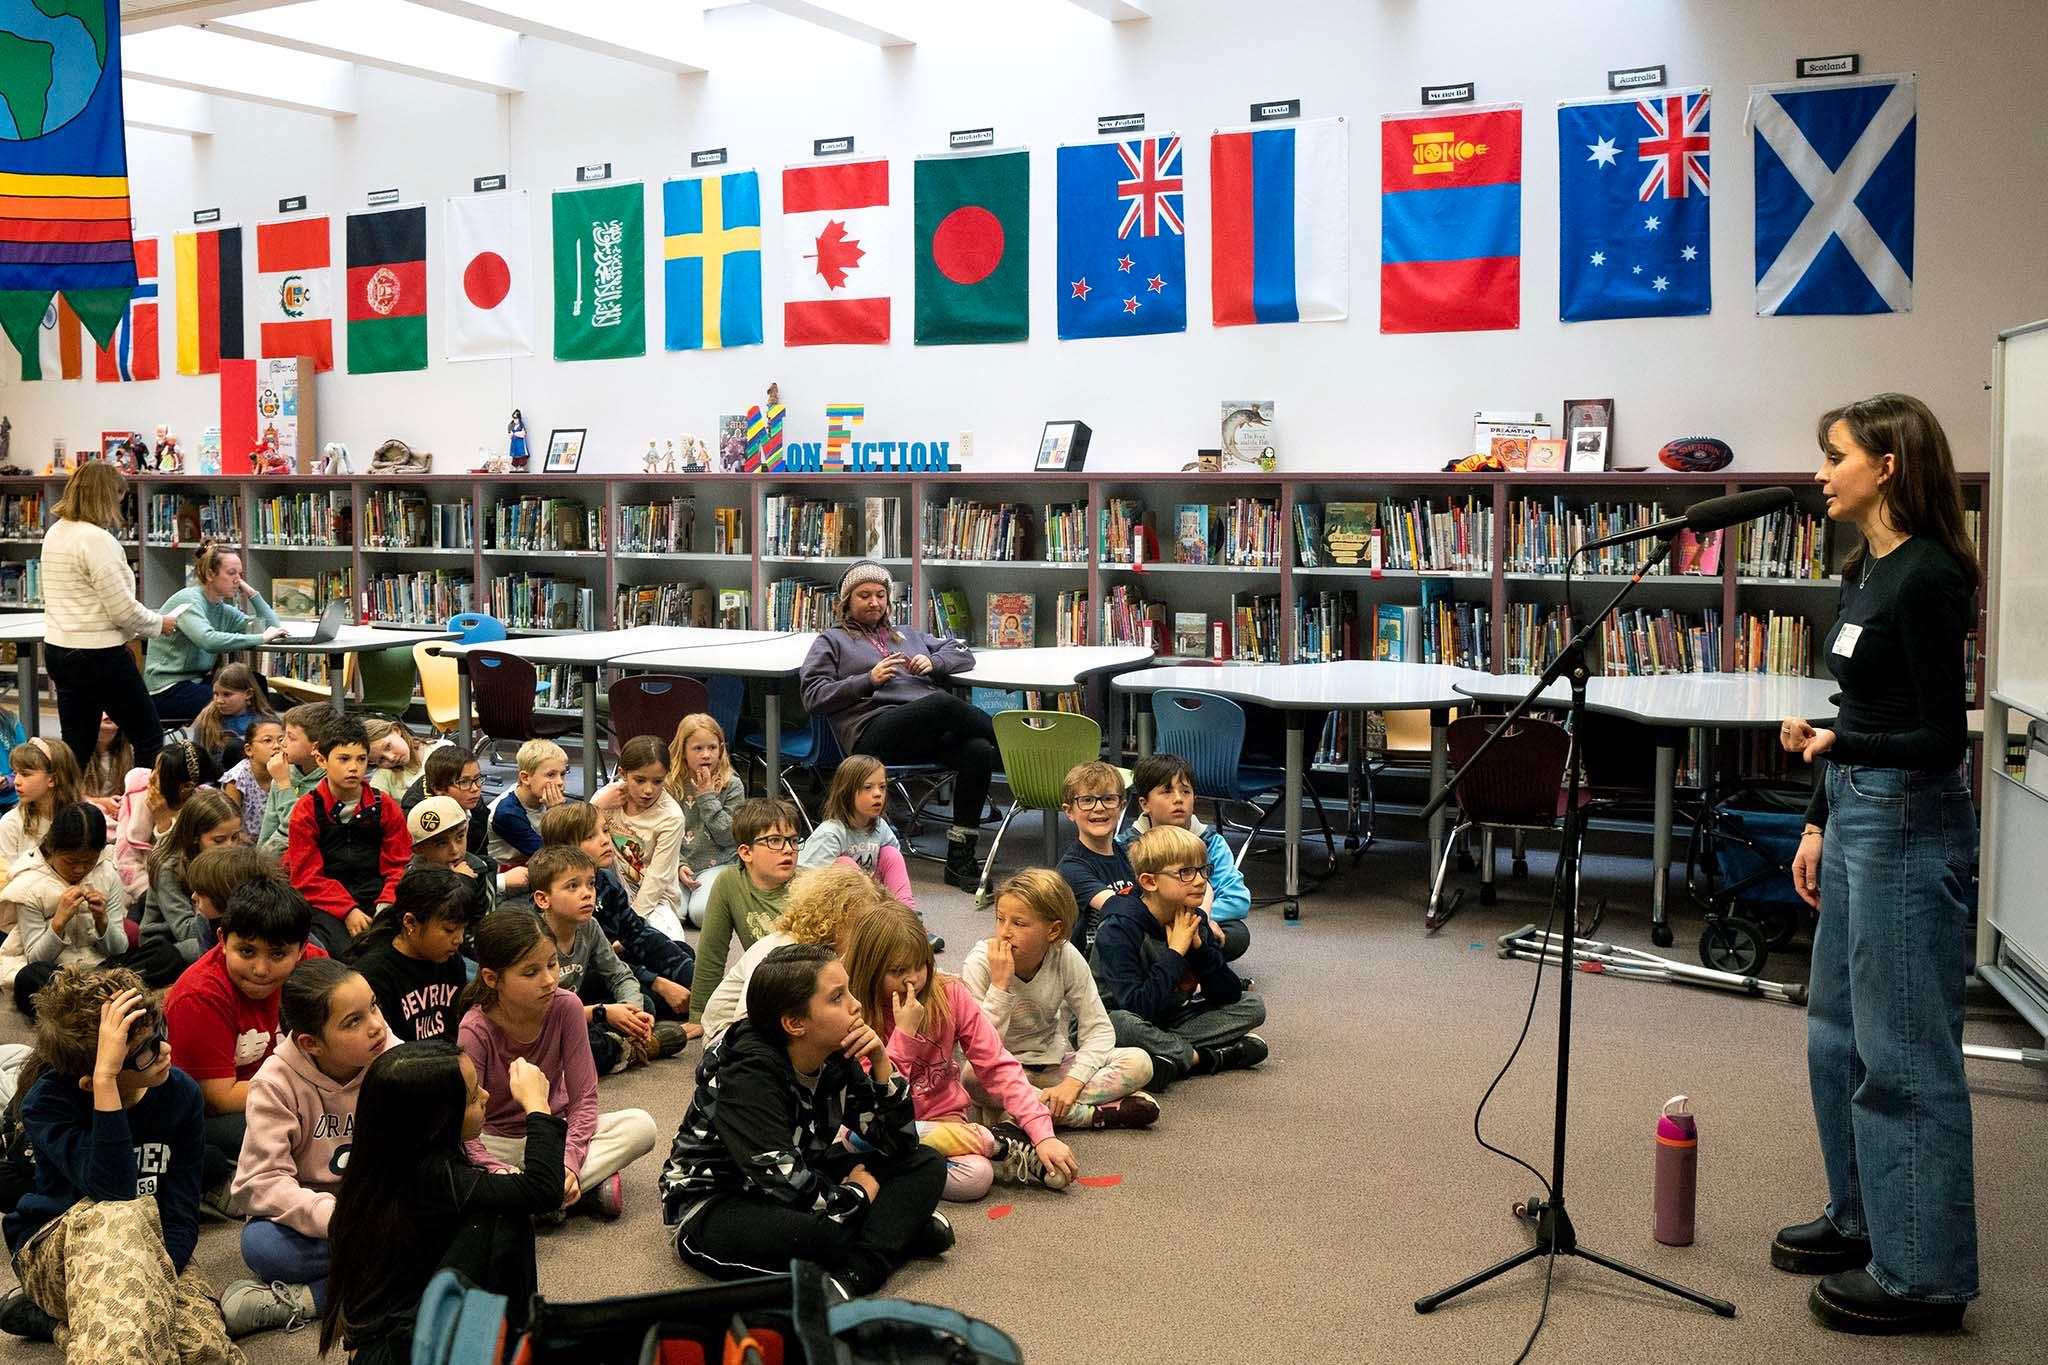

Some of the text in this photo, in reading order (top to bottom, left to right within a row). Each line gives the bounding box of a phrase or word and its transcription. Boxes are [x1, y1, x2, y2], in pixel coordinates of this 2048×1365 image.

[1808, 61, 1847, 72] Scotland
[1618, 73, 1656, 84] Australia
[744, 403, 950, 473] NON FICTION
[415, 1010, 445, 1040] HILLS
